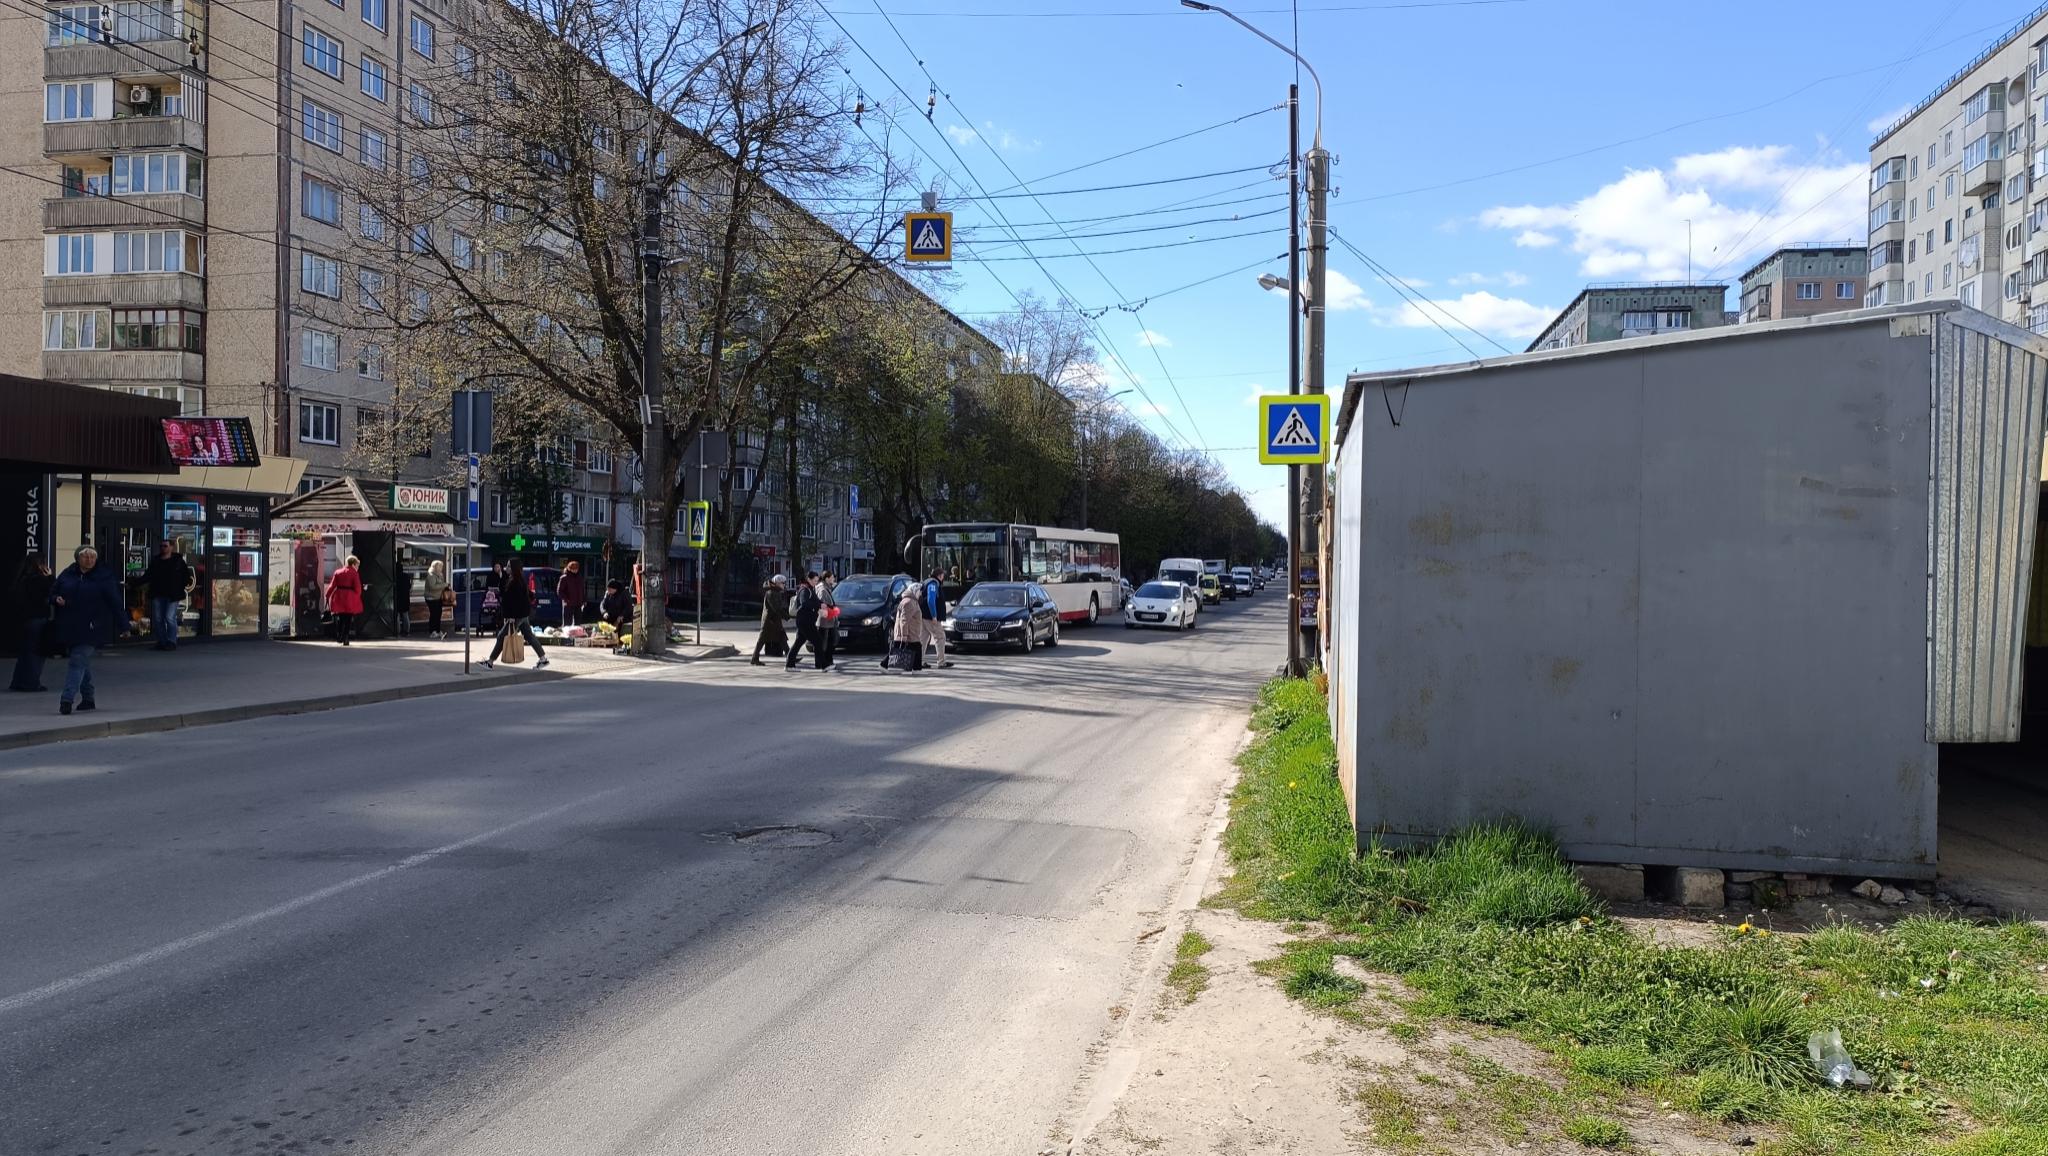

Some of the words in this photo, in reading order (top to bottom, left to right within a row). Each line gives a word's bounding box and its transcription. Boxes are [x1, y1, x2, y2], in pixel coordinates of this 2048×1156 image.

[102, 496, 149, 507] ЗАПРАВКА
[412, 489, 445, 504] ЮНИК
[26, 486, 39, 556] ПРАВКА
[961, 533, 971, 541] 16
[532, 540, 548, 549] АПТЕК
